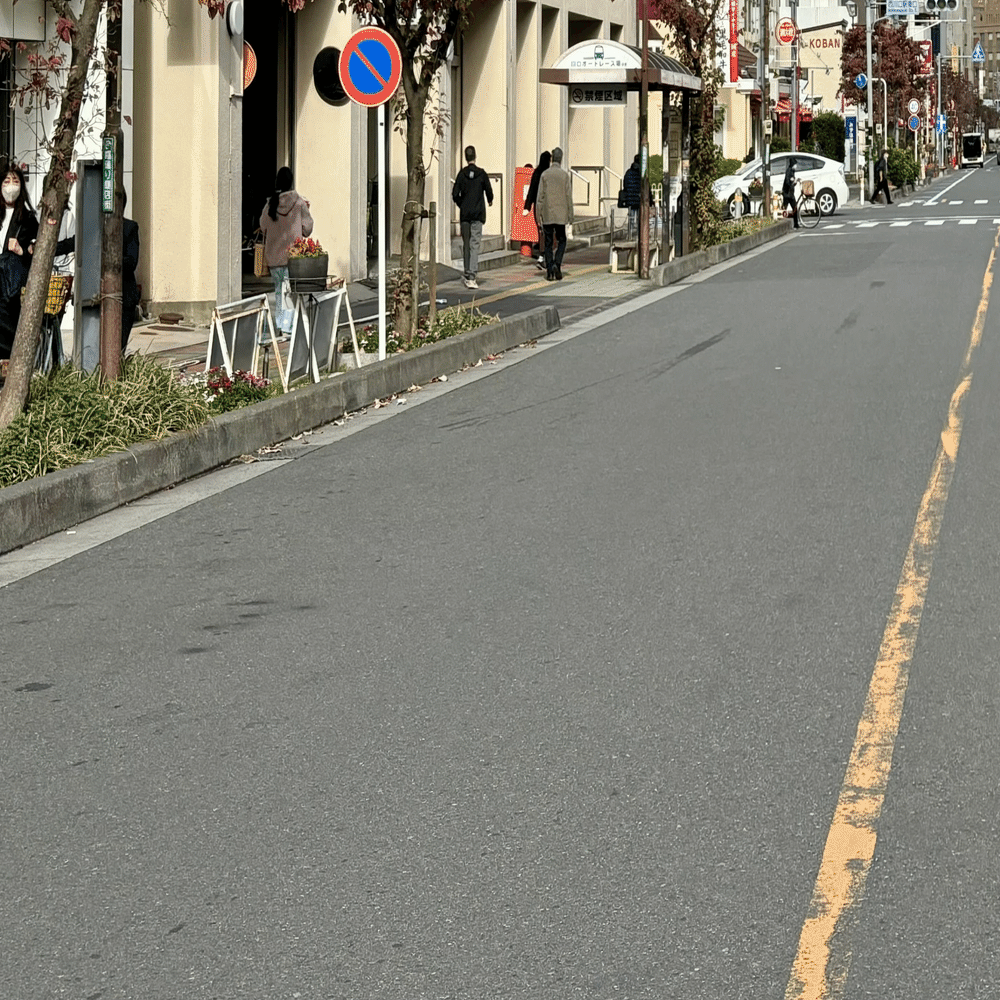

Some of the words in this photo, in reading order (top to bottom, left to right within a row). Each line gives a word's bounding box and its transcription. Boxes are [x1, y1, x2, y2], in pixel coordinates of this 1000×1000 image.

[809, 38, 841, 49] KOBAN
[584, 90, 623, 102] 禁煙区域
